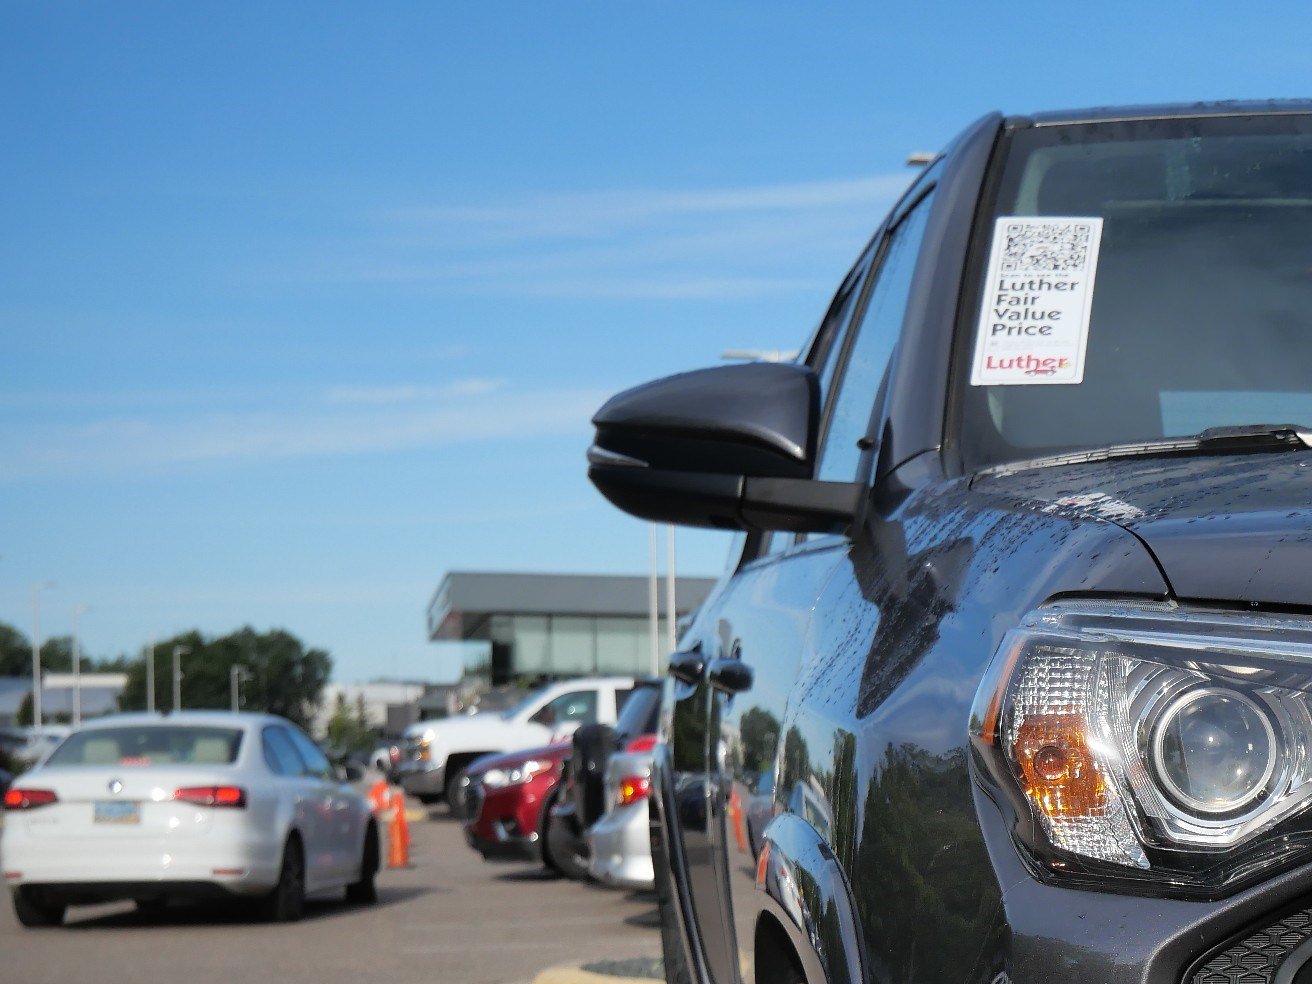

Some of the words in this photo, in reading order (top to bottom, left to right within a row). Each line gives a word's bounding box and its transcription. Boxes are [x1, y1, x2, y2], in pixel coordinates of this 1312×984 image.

[998, 278, 1079, 291] Luther
[996, 293, 1040, 306] Fair
[994, 307, 1062, 321] Value
[991, 322, 1053, 336] Price
[986, 355, 1068, 370] Luther
